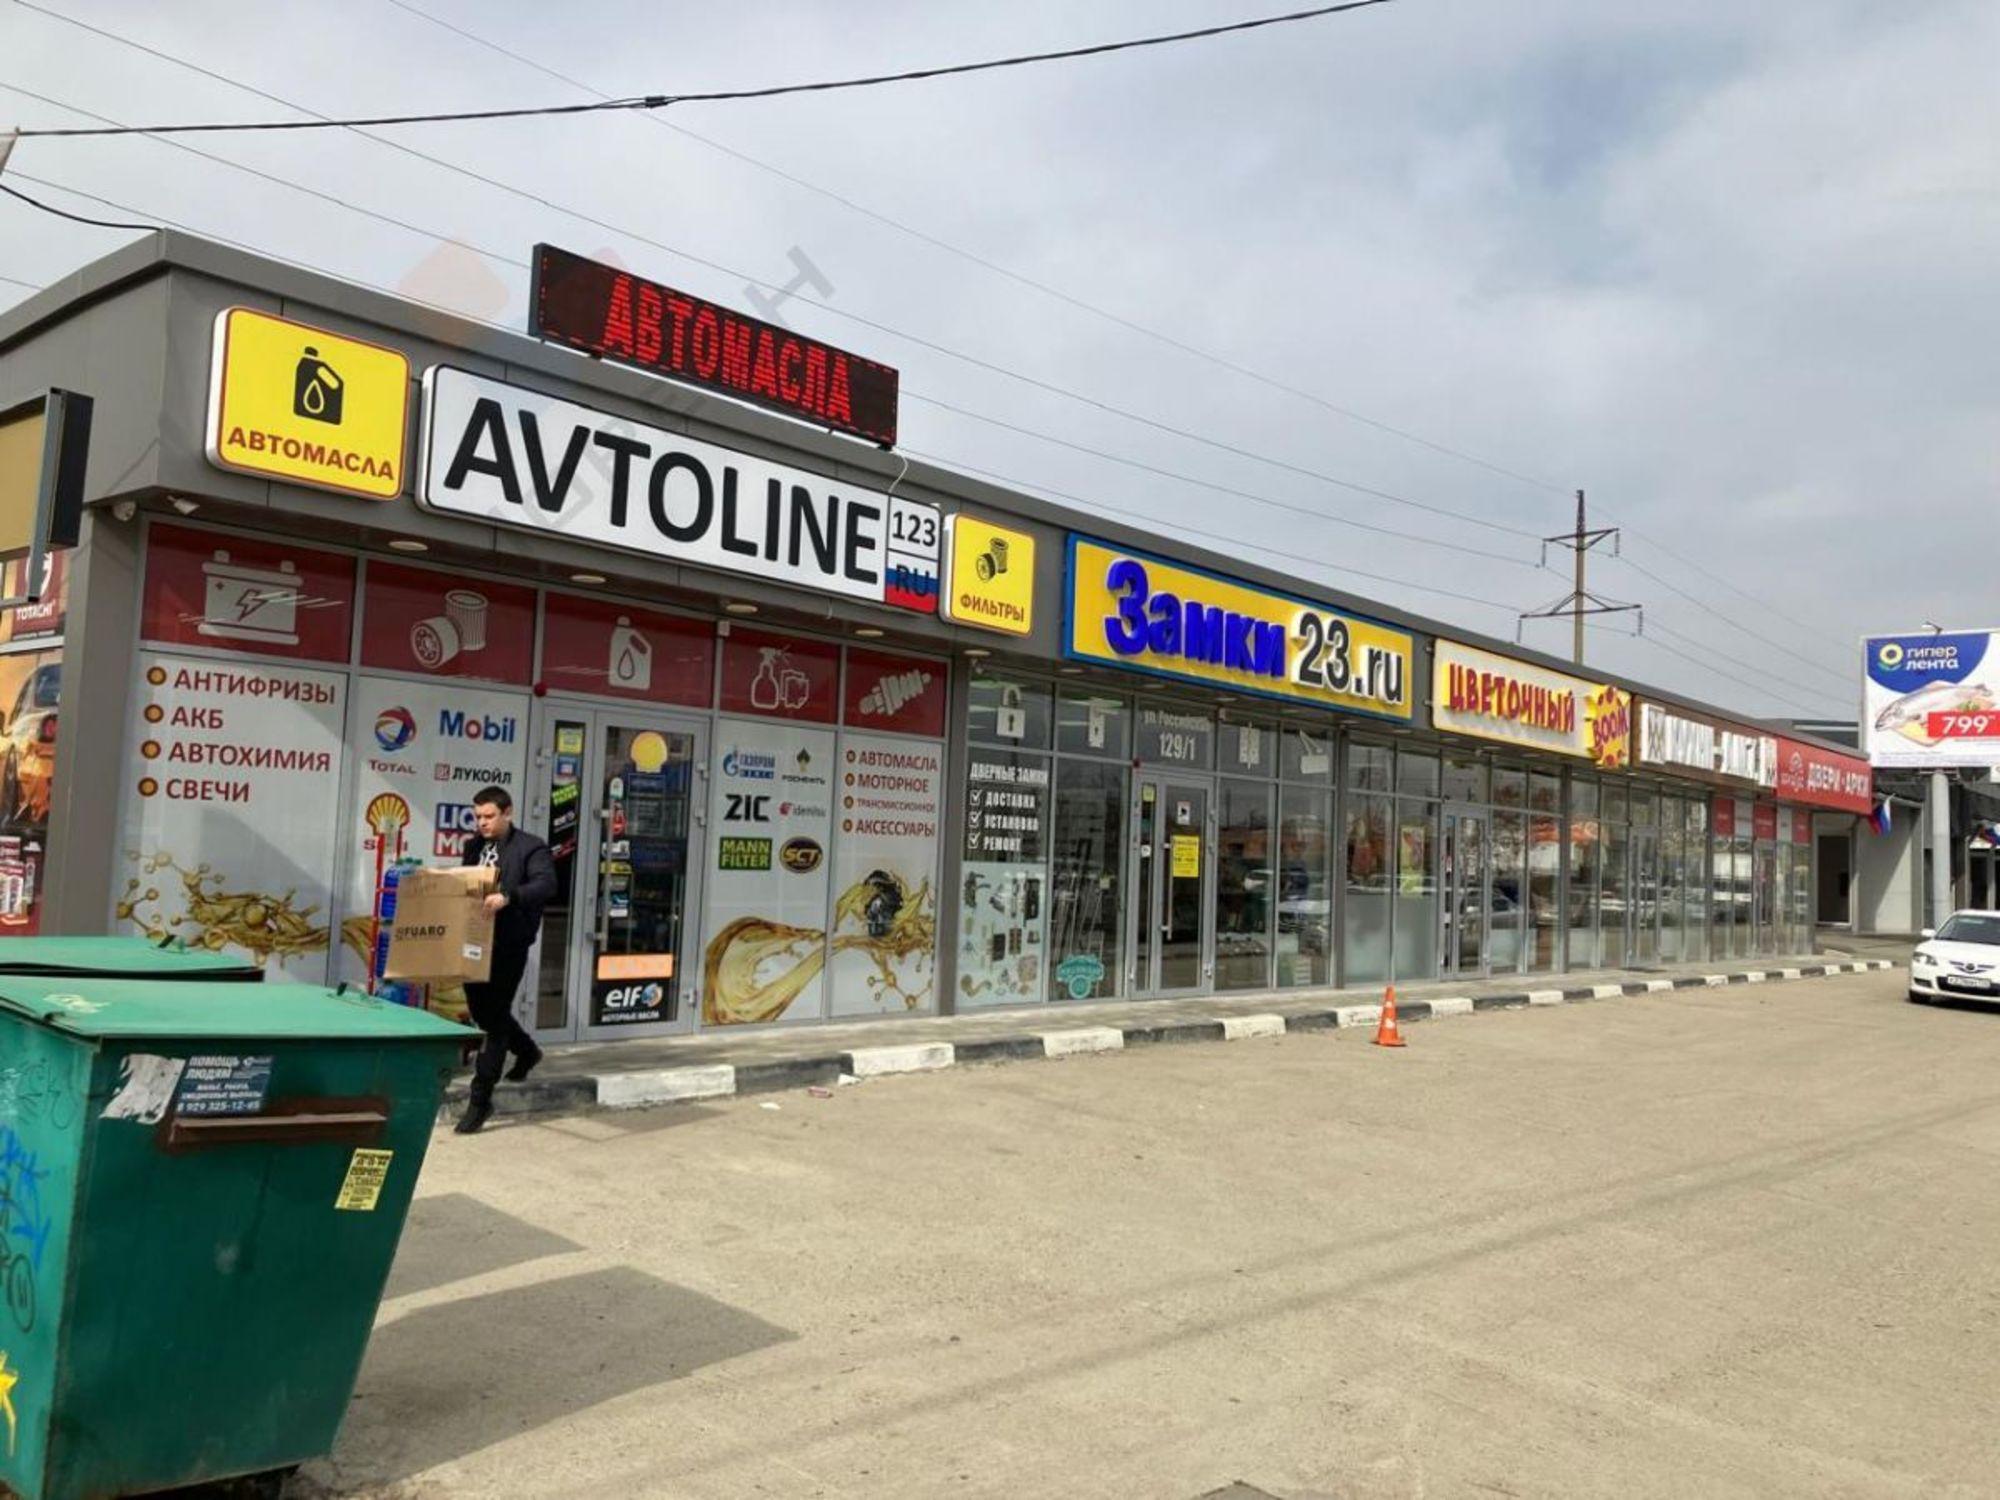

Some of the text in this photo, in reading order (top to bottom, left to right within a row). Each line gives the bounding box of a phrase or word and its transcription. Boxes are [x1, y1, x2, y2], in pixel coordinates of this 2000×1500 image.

[602, 272, 852, 422] АВТОМАСЛА
[227, 427, 395, 481] АВТОМАСЛА
[444, 397, 881, 584] AVTOLINE
[893, 511, 936, 547] 123
[896, 564, 930, 597] RU
[960, 594, 1024, 622] ФИЛЬТРЫ
[1105, 559, 1404, 704] Замки 23.ru
[1906, 645, 1958, 659] гипер
[1906, 658, 1959, 671] лента
[174, 669, 335, 704] АНТИФРИЗЫ
[1449, 663, 1575, 733] ЦВЕТОЧНЫЙ
[171, 706, 224, 729] АКБ
[439, 709, 516, 743] Mobil
[1942, 715, 1988, 735] 799
[168, 741, 330, 772] АВТОХИМИЯ
[1160, 731, 1195, 760] 129/1
[369, 759, 417, 774] TOTAL
[859, 751, 938, 771] АВТОМАСЛА
[453, 766, 512, 785] ЛУКОЙЛ
[858, 773, 929, 793] МОТОРНОЕ
[166, 778, 250, 802] СВЕЧИ
[724, 794, 771, 822] ZIC
[856, 818, 935, 837] АКСЕССУАРЫ
[723, 840, 769, 853] MANN
[983, 836, 1021, 851] РЕМОНТ
[722, 854, 769, 867] FILTER
[605, 985, 642, 1008] elf
